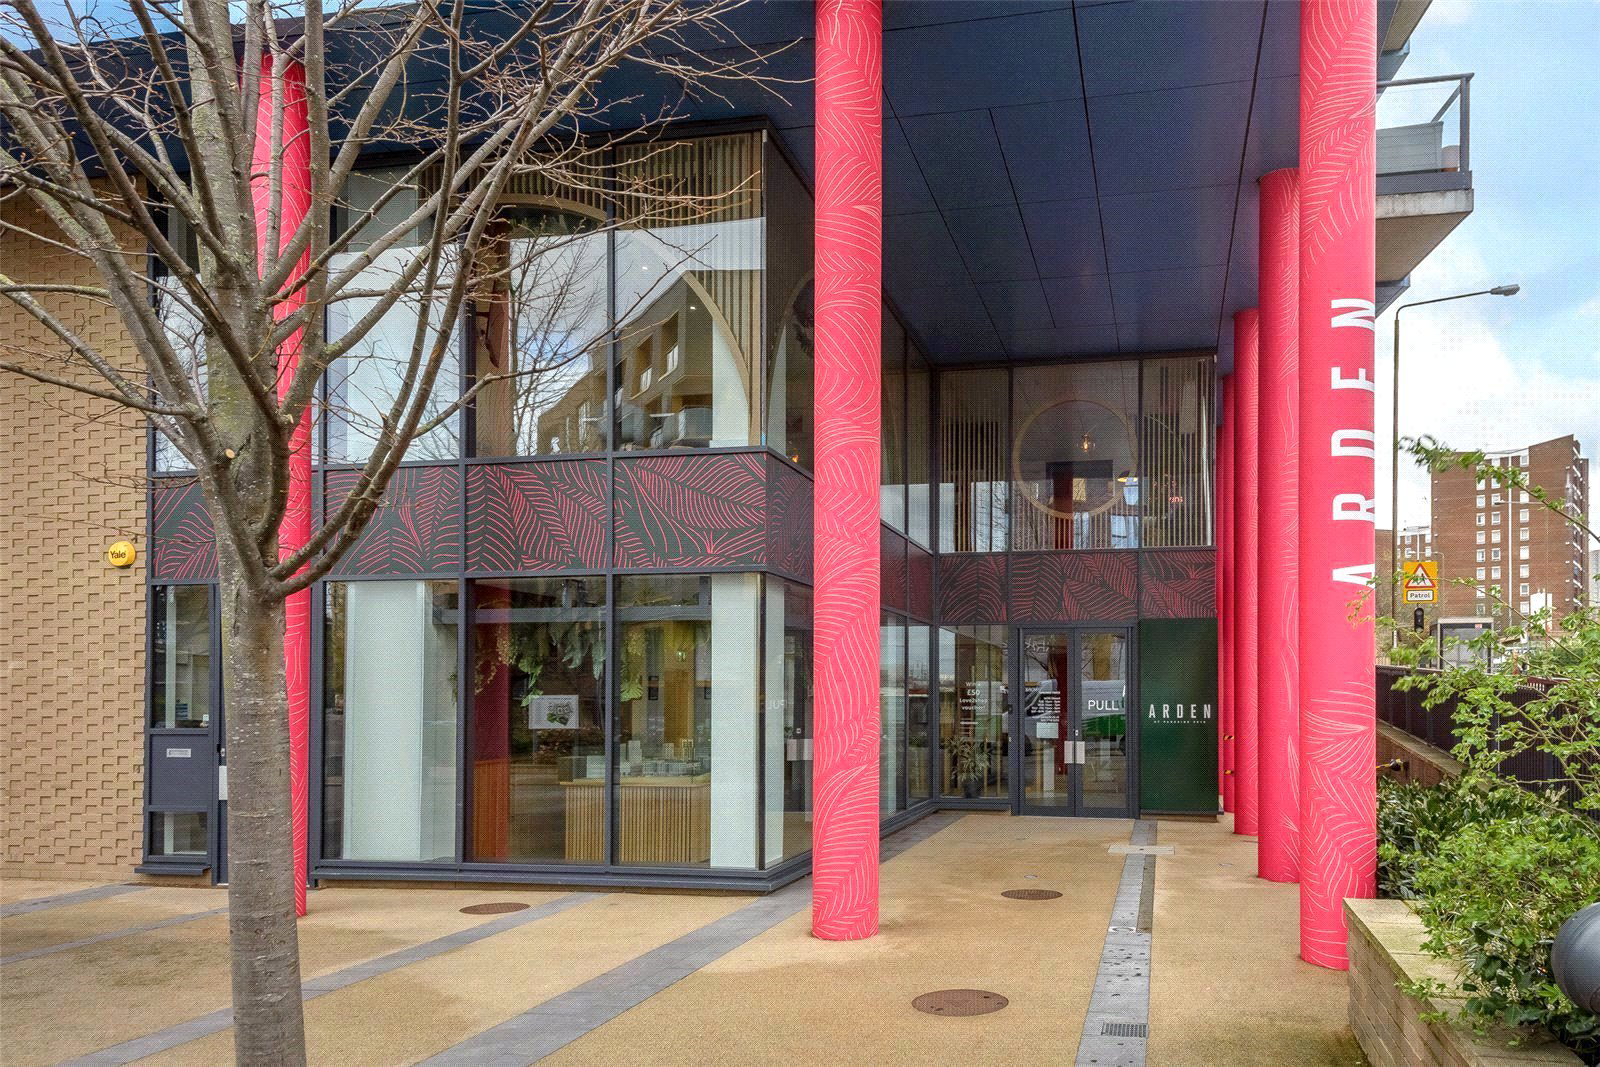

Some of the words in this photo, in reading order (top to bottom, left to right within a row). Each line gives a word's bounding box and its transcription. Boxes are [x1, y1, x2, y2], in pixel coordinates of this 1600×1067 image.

[1331, 298, 1375, 589] ARDEN
[110, 550, 126, 559] Yale
[1088, 699, 1119, 711] PULL
[1149, 703, 1211, 719] ARDEN
